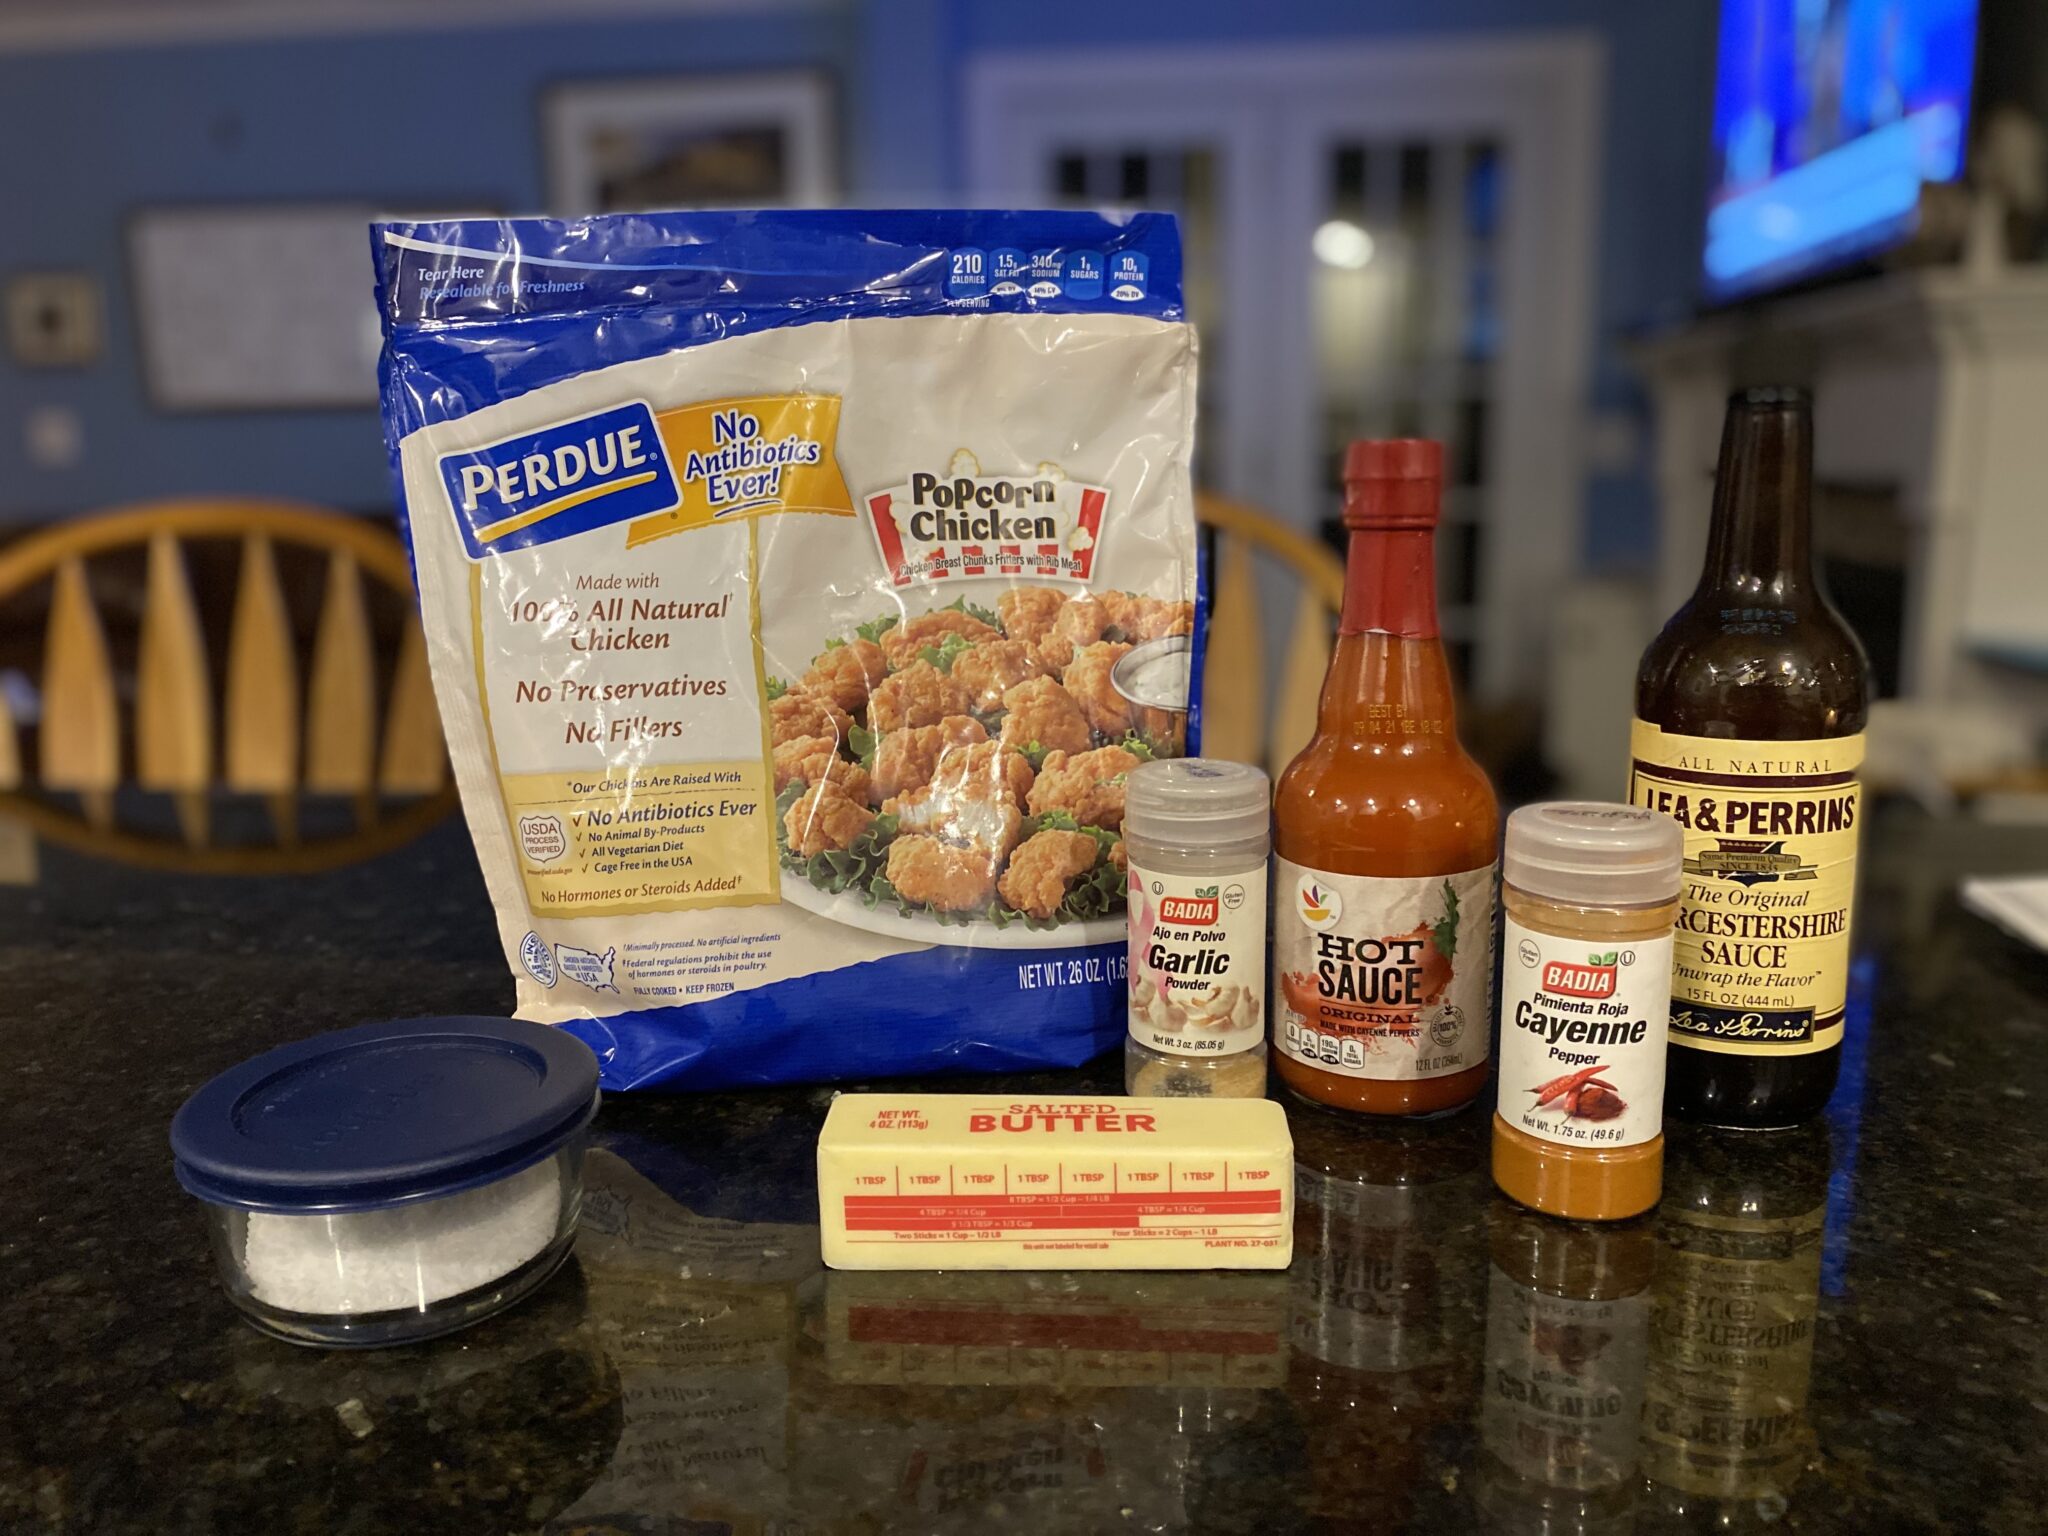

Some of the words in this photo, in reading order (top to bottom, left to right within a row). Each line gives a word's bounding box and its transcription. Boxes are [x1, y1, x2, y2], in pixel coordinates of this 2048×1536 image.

[953, 254, 982, 274] 210
[1122, 258, 1138, 272] 10g
[418, 268, 449, 281] Tear
[451, 266, 484, 279] Here
[951, 275, 985, 284] CALORIES
[1032, 269, 1060, 278] SODIUM
[1071, 269, 1099, 280] SUGARS
[1114, 271, 1144, 281] PROTEIN
[420, 283, 493, 300] Resealable
[519, 280, 585, 294] Freshness
[713, 412, 756, 443] No
[687, 435, 820, 480] Antibiotics
[460, 425, 647, 511] PERDUE
[708, 465, 778, 503] Ever!
[912, 472, 1056, 509] Popcorn
[910, 508, 1056, 542] Chicken
[901, 558, 933, 577] Chicken
[935, 553, 962, 570] Breast
[963, 553, 994, 567] Chunks
[995, 553, 1025, 566] Fritters
[1026, 553, 1044, 566] with
[1046, 555, 1059, 568] Rib
[1061, 558, 1082, 571] Meat
[576, 574, 622, 591] Made
[626, 572, 660, 590] with
[587, 598, 624, 622] All
[571, 627, 670, 651] Chicken
[516, 681, 552, 703] No
[560, 674, 728, 702] Preservatives
[1369, 704, 1392, 718] BEST
[1396, 703, 1408, 718] BY
[565, 721, 601, 744] No
[610, 716, 683, 742] Fillers
[1679, 756, 1715, 771] ALL
[1729, 759, 1832, 774] NATURAL
[650, 776, 671, 787] Are
[673, 773, 711, 786] Raised
[714, 771, 742, 784] With
[587, 810, 612, 827] No
[616, 802, 714, 824] Antibiotics
[719, 800, 757, 817] Ever
[523, 823, 558, 835] USDA
[588, 832, 603, 843] No
[604, 828, 642, 841] Animal
[643, 824, 705, 839] By-Products
[525, 836, 559, 844] PROCESS
[527, 845, 561, 854] VERIFIED
[591, 846, 606, 858] All
[607, 843, 661, 857] Vegetarian
[663, 841, 684, 852] Diet
[594, 863, 618, 875] Cage
[620, 861, 640, 871] Free
[642, 860, 651, 869] in
[653, 858, 669, 868] the
[671, 856, 693, 867] USA
[1720, 862, 1752, 870] SINCE
[541, 890, 556, 903] No
[558, 887, 622, 903] Hormones
[625, 886, 638, 897] or
[641, 881, 691, 897] Steroids
[1688, 884, 1722, 903] The
[1728, 889, 1810, 908] Original
[1163, 900, 1214, 920] BADIA
[1674, 907, 1846, 939] RCESTERSHIRE
[660, 938, 695, 951] processed.
[709, 935, 740, 946] artificial
[741, 933, 781, 945] ingredients
[1152, 926, 1171, 940] Ajo
[1174, 931, 1190, 941] en
[1192, 930, 1226, 942] Polvo
[1317, 932, 1424, 965] HOT
[1700, 940, 1787, 969] SAUCE
[657, 954, 703, 968] regulations
[704, 952, 739, 965] prohibit
[741, 951, 755, 960] the
[757, 951, 772, 959] use
[1148, 944, 1231, 975] Garlic
[636, 968, 675, 978] hormones
[688, 964, 721, 975] steroids
[733, 961, 767, 973] poultry.
[1019, 963, 1042, 990] NET
[1043, 961, 1066, 987] WT.
[1068, 960, 1083, 985] 26
[1085, 958, 1104, 983] OZ.
[1164, 976, 1211, 992] Powder
[1318, 959, 1423, 1005] SAUCE
[1546, 966, 1611, 992] BADIA
[1736, 972, 1762, 987] the
[652, 986, 677, 996] COOKED
[685, 984, 705, 994] KEEP
[706, 982, 735, 993] FROZEN
[1687, 987, 1700, 1000] 15
[1703, 990, 1717, 1003] FL
[1720, 993, 1739, 1005] OZ
[1742, 994, 1769, 1008] (444
[1772, 995, 1795, 1008] mL)
[1533, 992, 1594, 1015] Pimienta
[1597, 1003, 1629, 1018] Roja
[1320, 1005, 1421, 1025] ORIGINAL
[1515, 1000, 1647, 1045] Cayenne
[1670, 1009, 1710, 1033] Lea
[1738, 1013, 1805, 1039] Perrins
[1320, 1020, 1336, 1030] MADE
[1339, 1024, 1356, 1034] WITH
[1356, 1027, 1387, 1037] CAYENNE
[1389, 1028, 1420, 1038] PEPPERS
[1153, 1034, 1164, 1045] Net
[1548, 1047, 1600, 1066] Pepper
[878, 1110, 899, 1119] NET
[902, 1110, 921, 1119] WT.
[1008, 1104, 1117, 1115] SALTED
[869, 1120, 877, 1129] 4
[878, 1120, 895, 1129] OZ.
[897, 1119, 929, 1130] (113g)
[969, 1114, 1157, 1133] BUTTER
[1522, 1114, 1535, 1127] Net
[1536, 1120, 1550, 1133] Wt.
[1553, 1125, 1573, 1137] 1.75
[1575, 1129, 1588, 1140] oz.
[1590, 1128, 1614, 1142] (49.6
[1616, 1127, 1625, 1141] g)
[863, 1177, 887, 1185] TBSP
[916, 1176, 941, 1185] TBSP
[970, 1175, 995, 1184] TBSP
[1025, 1174, 1050, 1183] TBSP
[1080, 1173, 1104, 1182] TBSP
[1134, 1172, 1159, 1181] TBSP
[1190, 1172, 1214, 1181] TBSP
[1244, 1171, 1270, 1180] TBSP
[894, 1232, 914, 1240] Two
[914, 1231, 938, 1239] Sticks
[952, 1231, 969, 1241] Cup
[1112, 1229, 1130, 1237] Four
[1132, 1228, 1156, 1237] Sticks
[1172, 1228, 1192, 1238] Cups
[1205, 1240, 1232, 1248] PLANT
